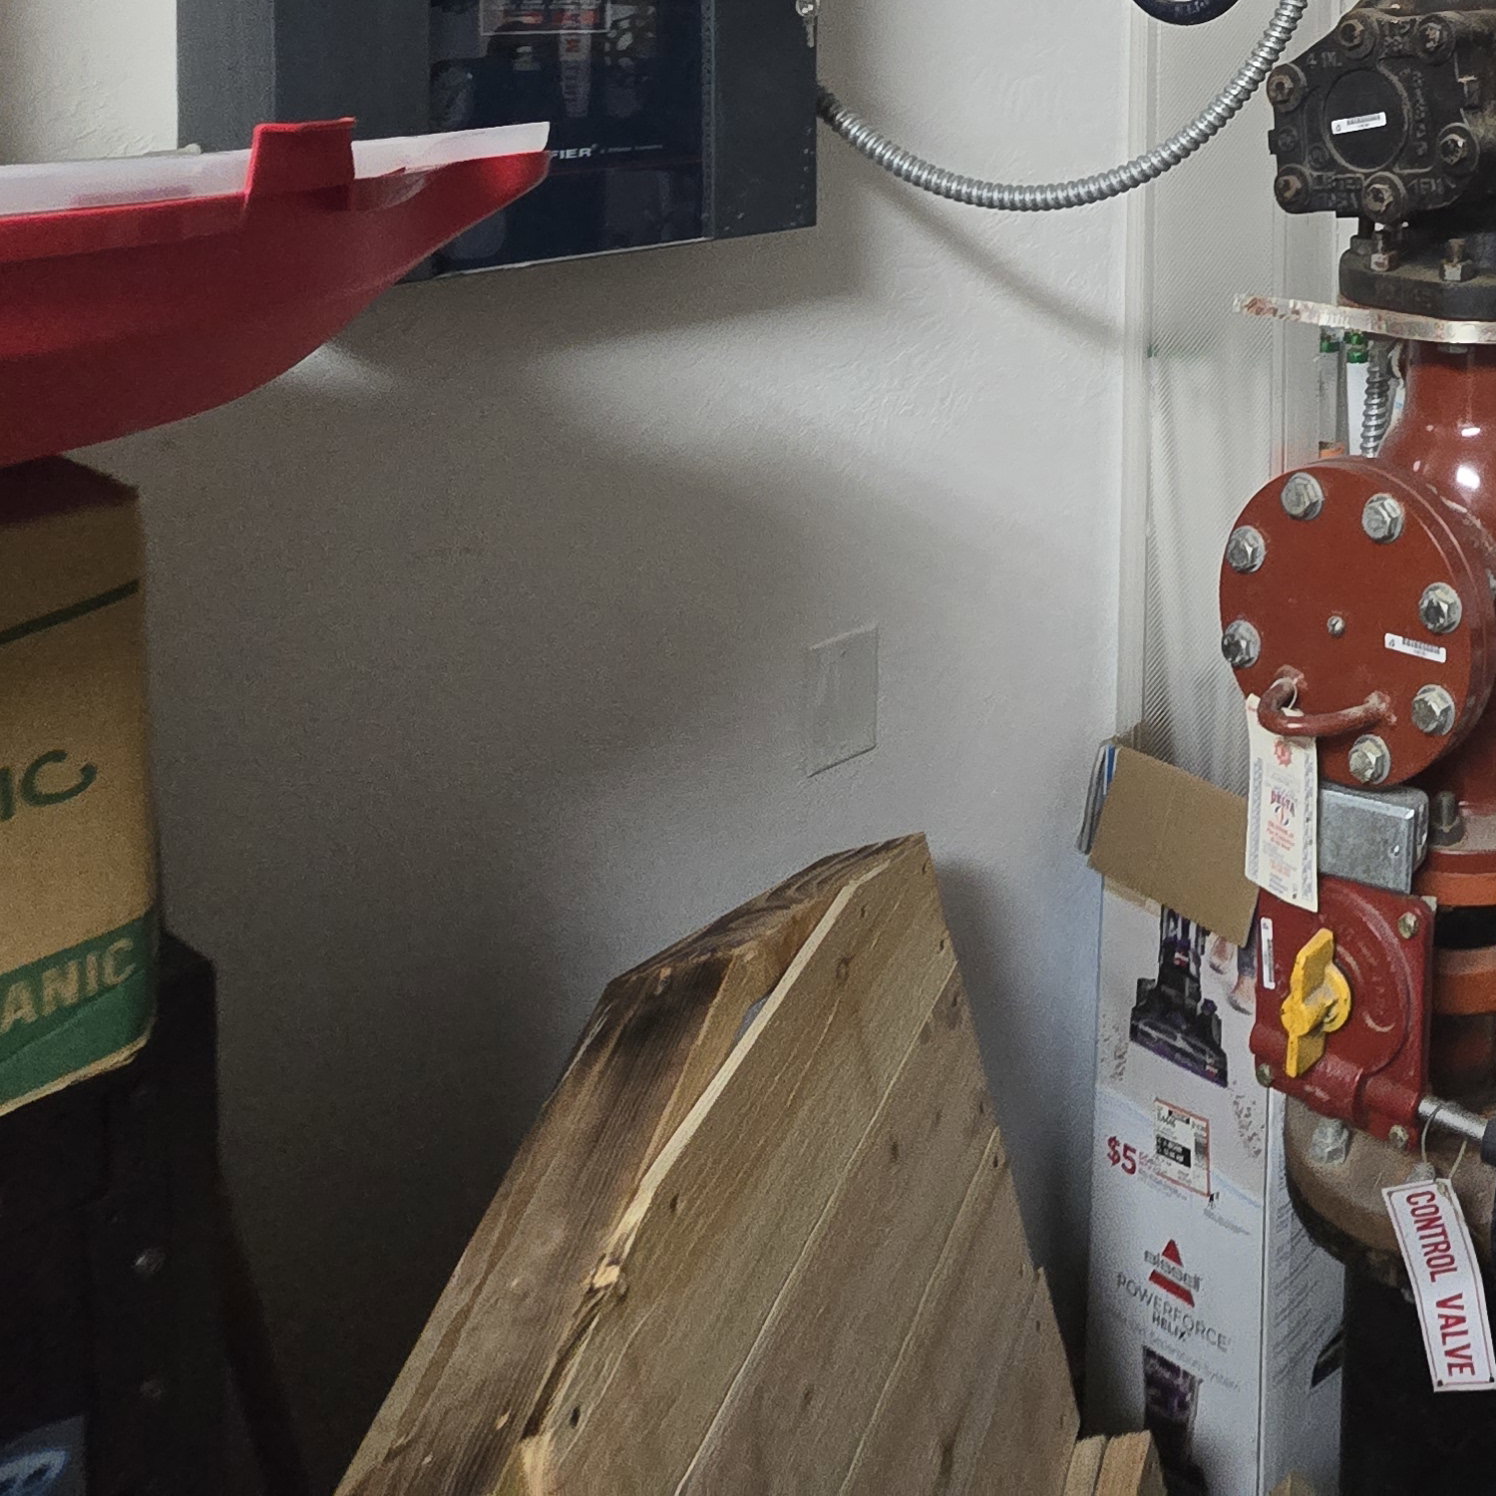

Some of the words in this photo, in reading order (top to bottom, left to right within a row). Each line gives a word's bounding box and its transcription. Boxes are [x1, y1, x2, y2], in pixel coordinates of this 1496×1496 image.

[551, 148, 592, 160] FIER
[1107, 1135, 1137, 1175] $5
[1116, 1271, 1229, 1353] POWERFORCE
[1406, 1190, 1458, 1283] CONTROL
[1435, 1292, 1476, 1377] VALVE
